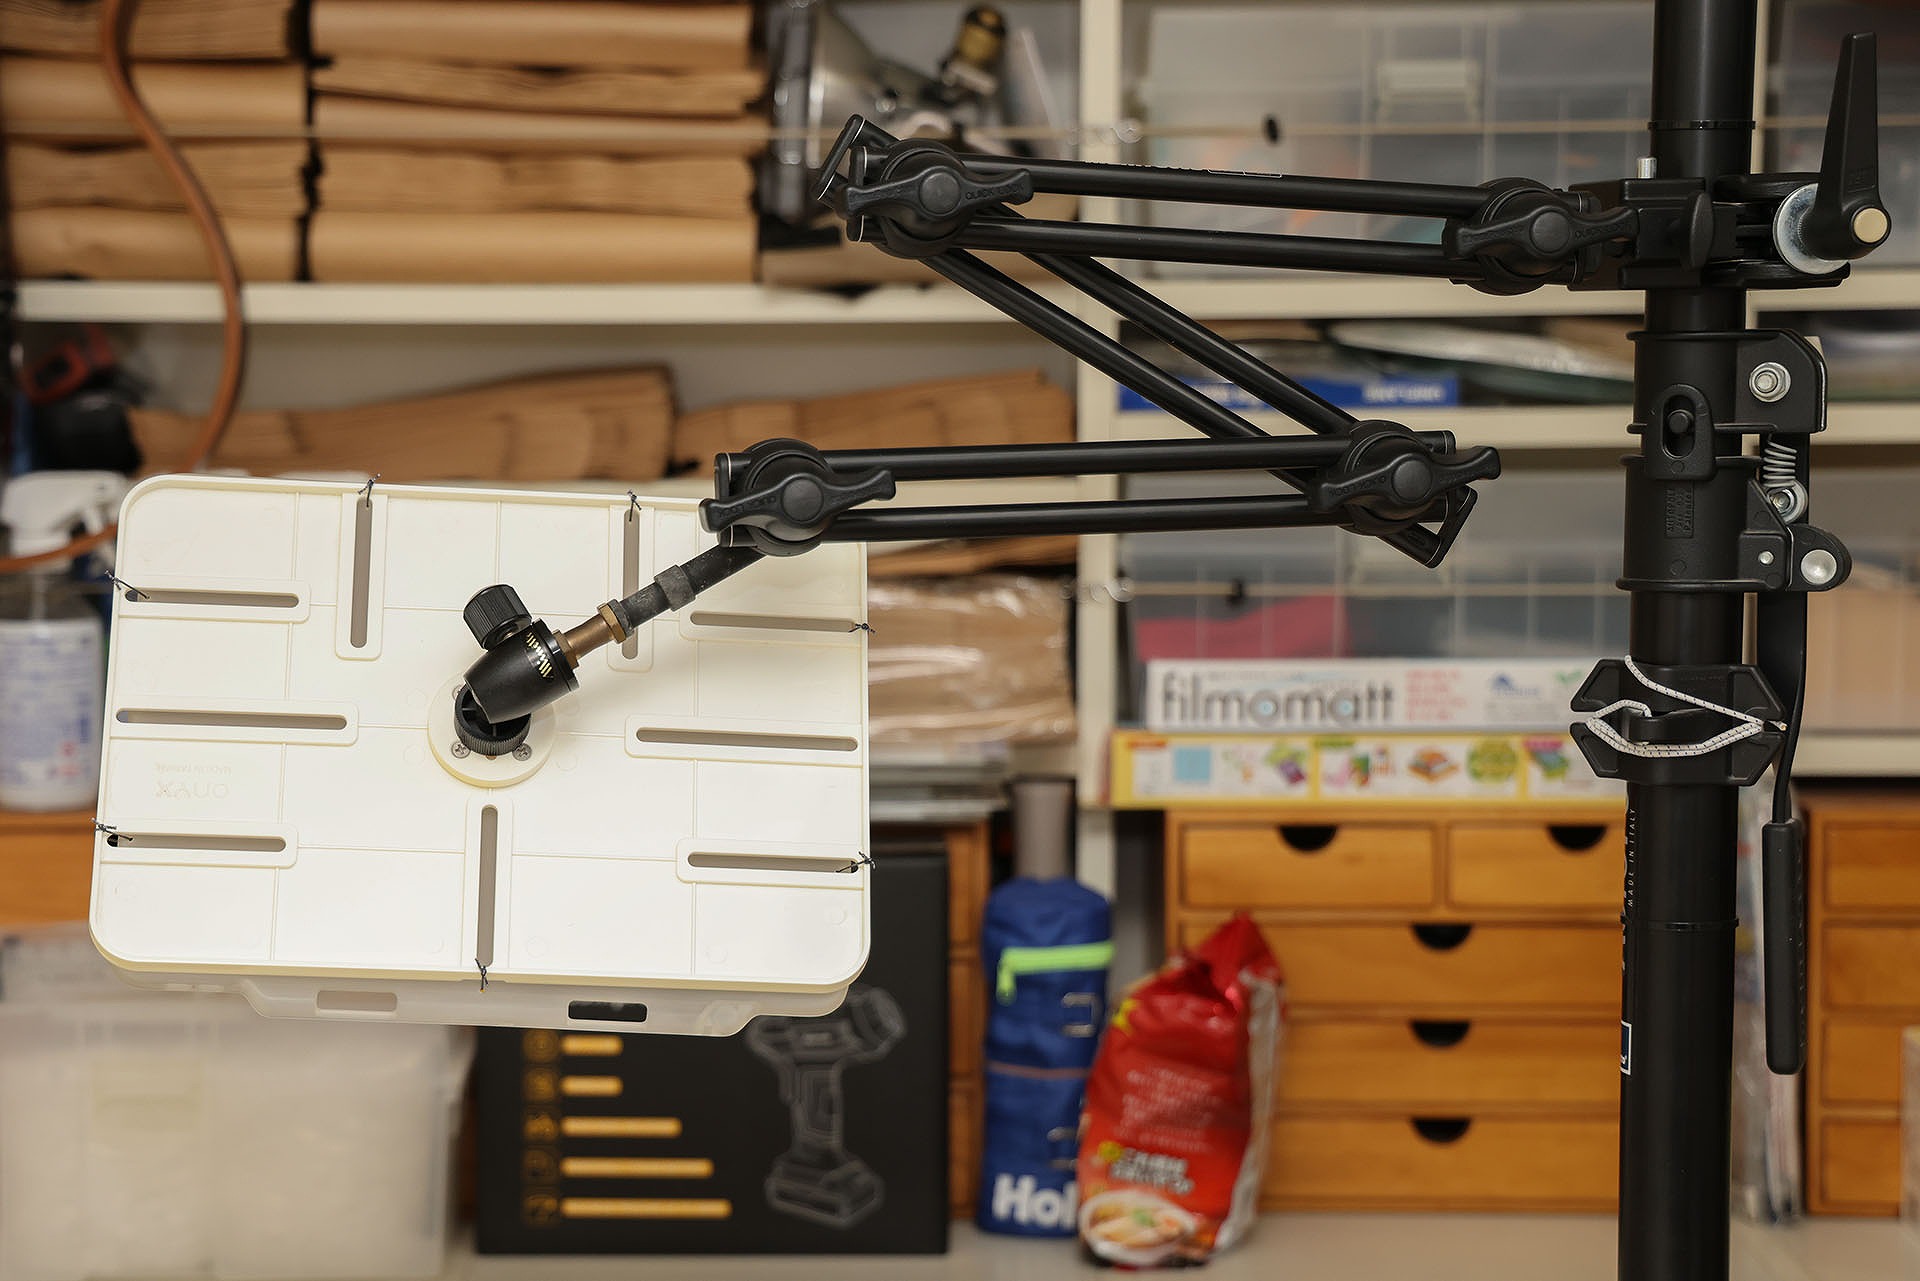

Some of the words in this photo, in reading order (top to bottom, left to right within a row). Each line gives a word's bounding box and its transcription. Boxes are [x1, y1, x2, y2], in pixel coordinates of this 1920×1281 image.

[1628, 808, 1636, 845] ITALY
[1628, 850, 1635, 863] IN
[1627, 872, 1635, 908] MADE
